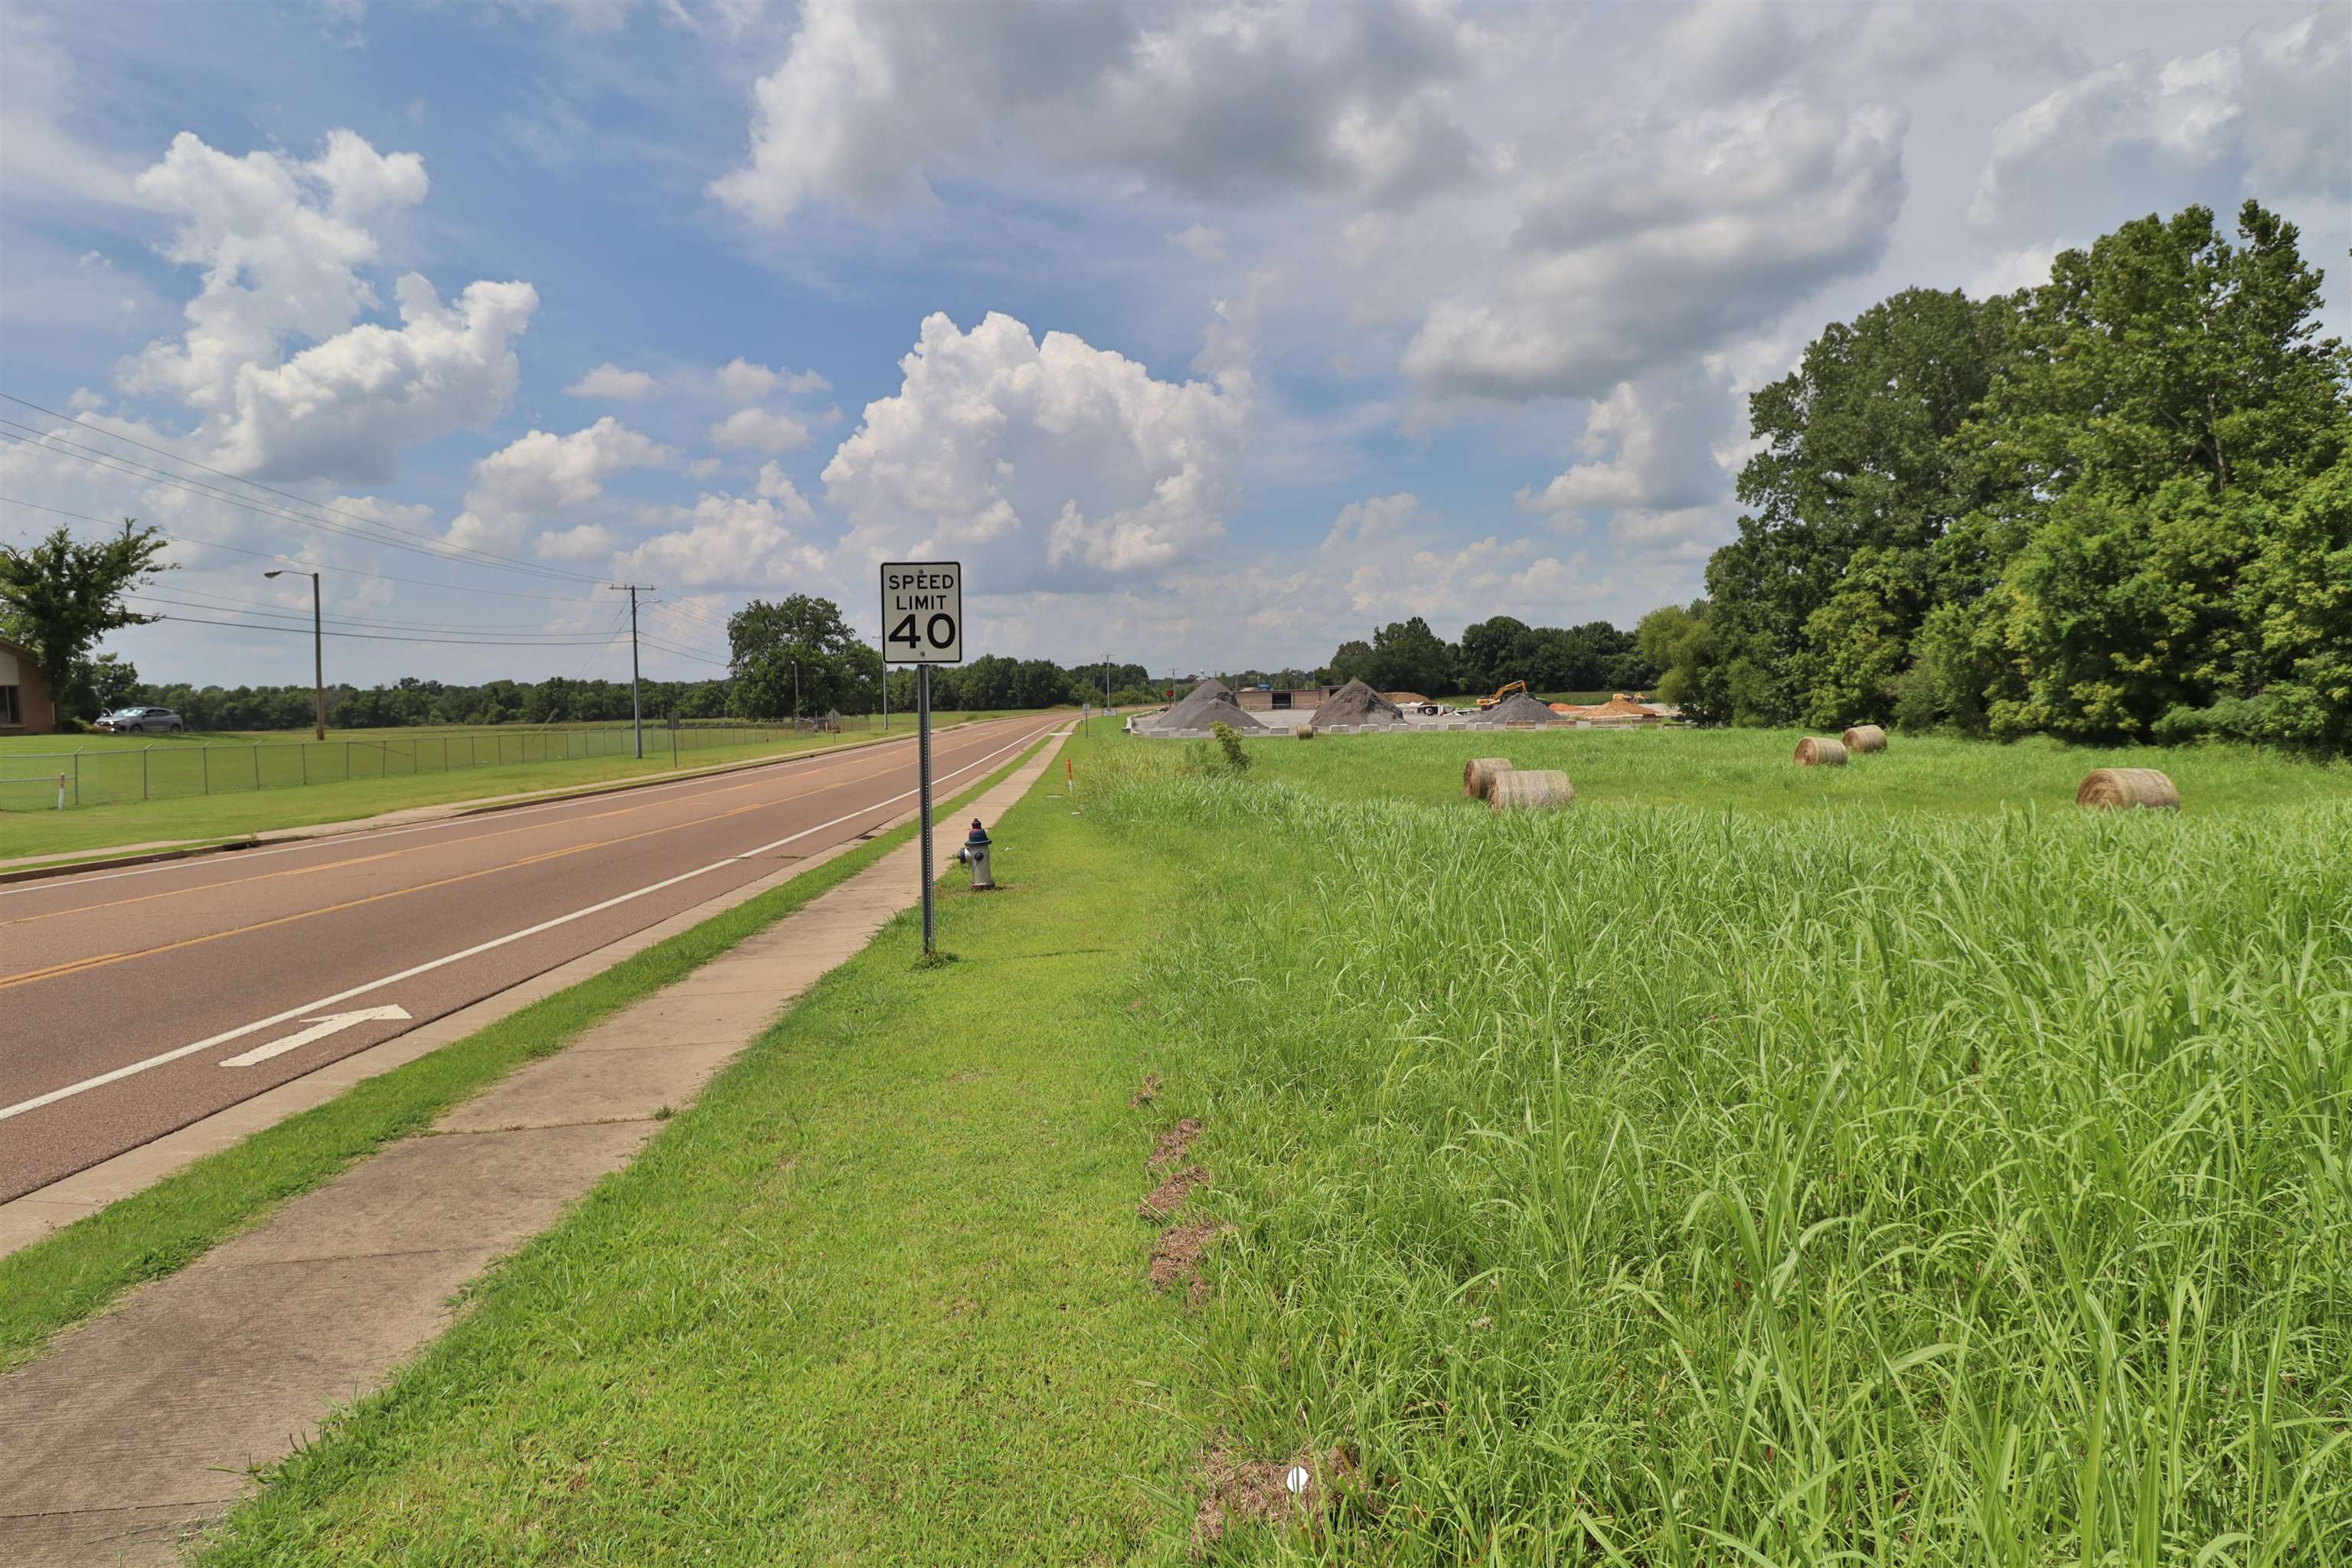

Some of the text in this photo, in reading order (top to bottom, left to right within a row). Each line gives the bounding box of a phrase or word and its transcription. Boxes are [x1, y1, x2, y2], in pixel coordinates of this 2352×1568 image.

[888, 574, 954, 590] SPEED
[897, 595, 946, 610] LIMIT
[888, 613, 956, 649] 40
